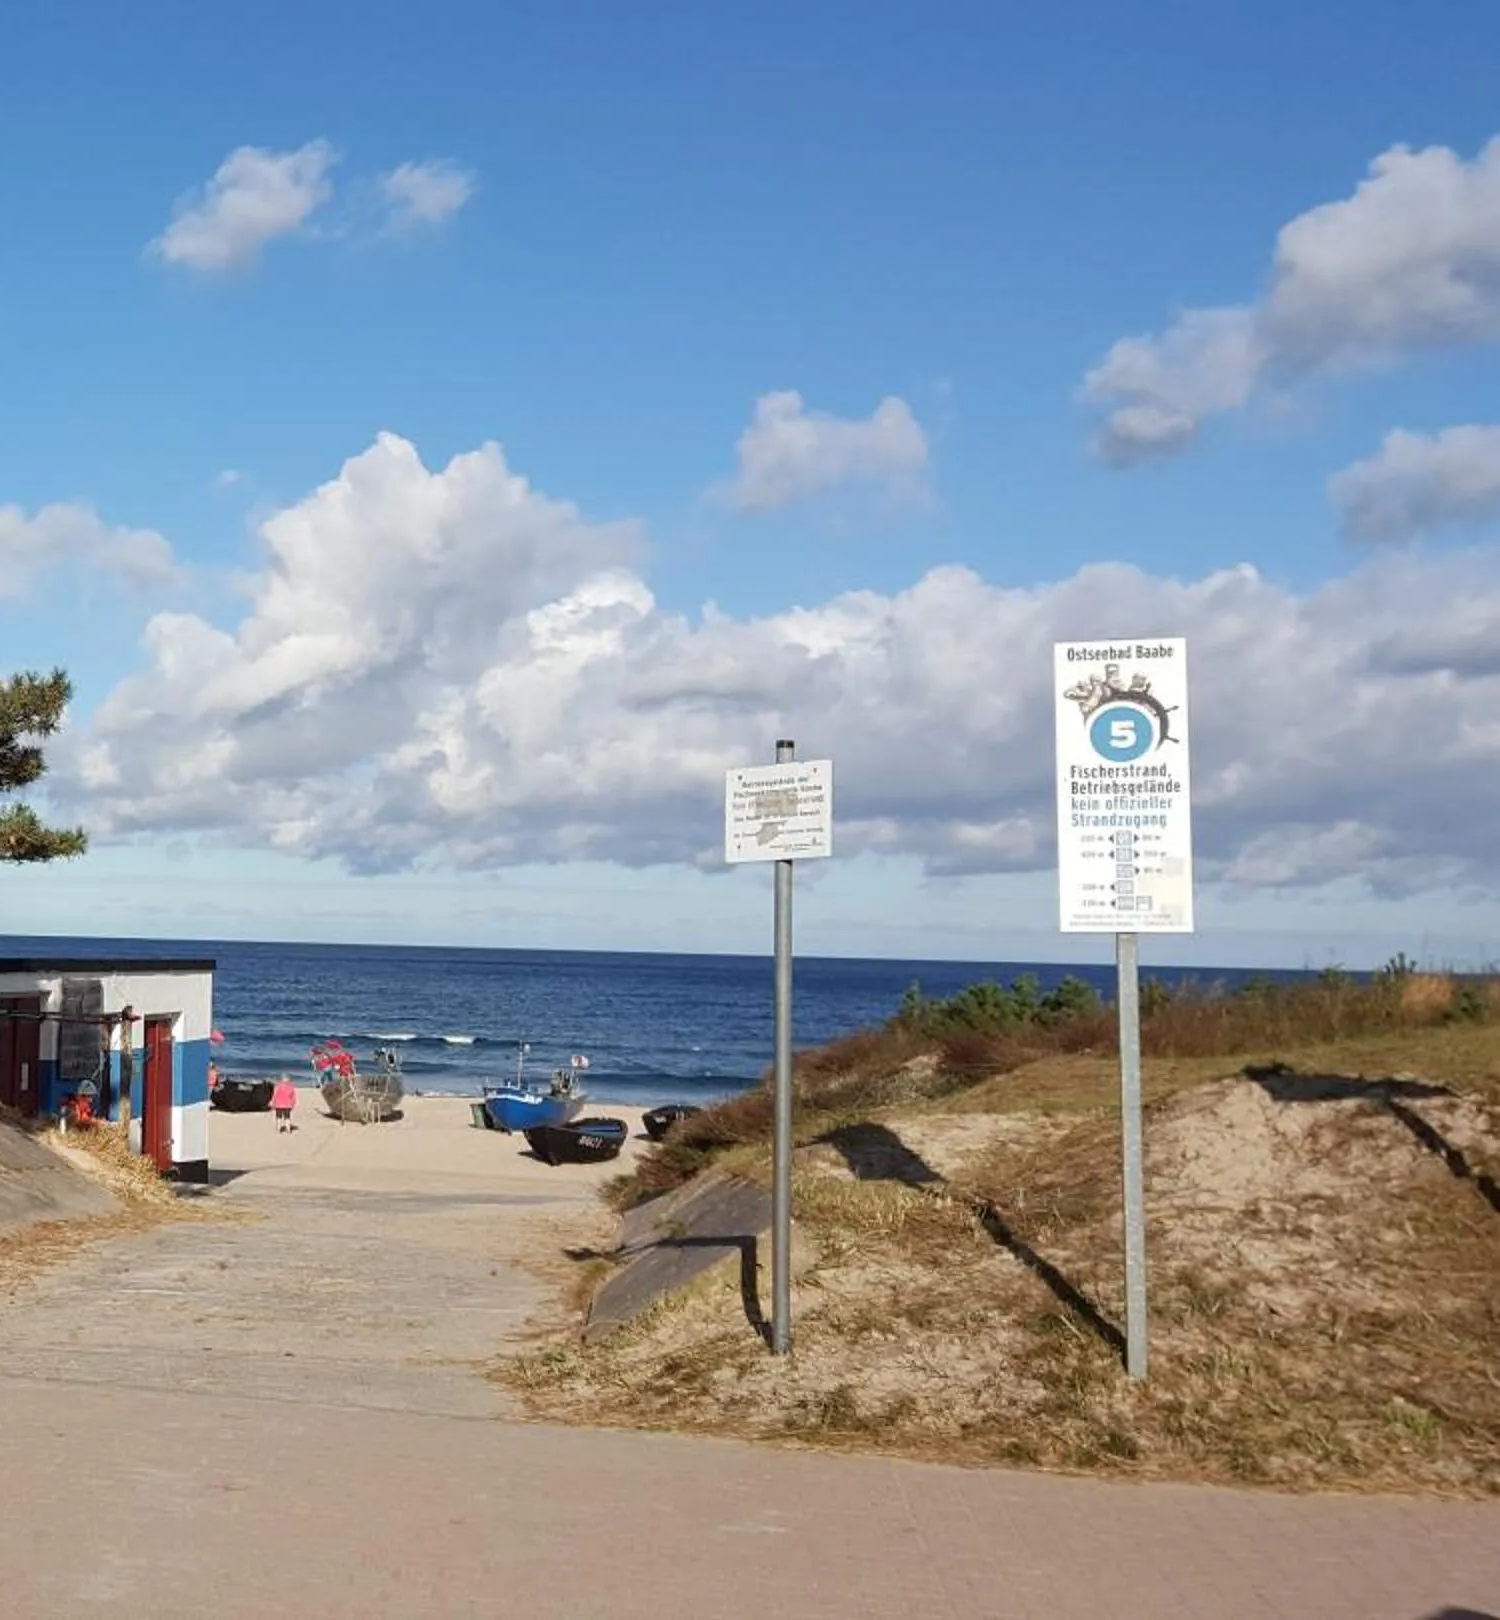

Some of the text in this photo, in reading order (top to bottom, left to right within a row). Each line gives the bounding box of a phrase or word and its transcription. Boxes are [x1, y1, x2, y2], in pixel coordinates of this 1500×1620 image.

[1067, 643, 1174, 662] Ostseebad Baabe
[1109, 719, 1137, 749] 5
[1070, 762, 1172, 779] Fischerstrand,
[1071, 779, 1181, 796] Betriebsgelände
[1071, 795, 1173, 811] kein offizieller
[1071, 812, 1167, 829] Strandzugang
